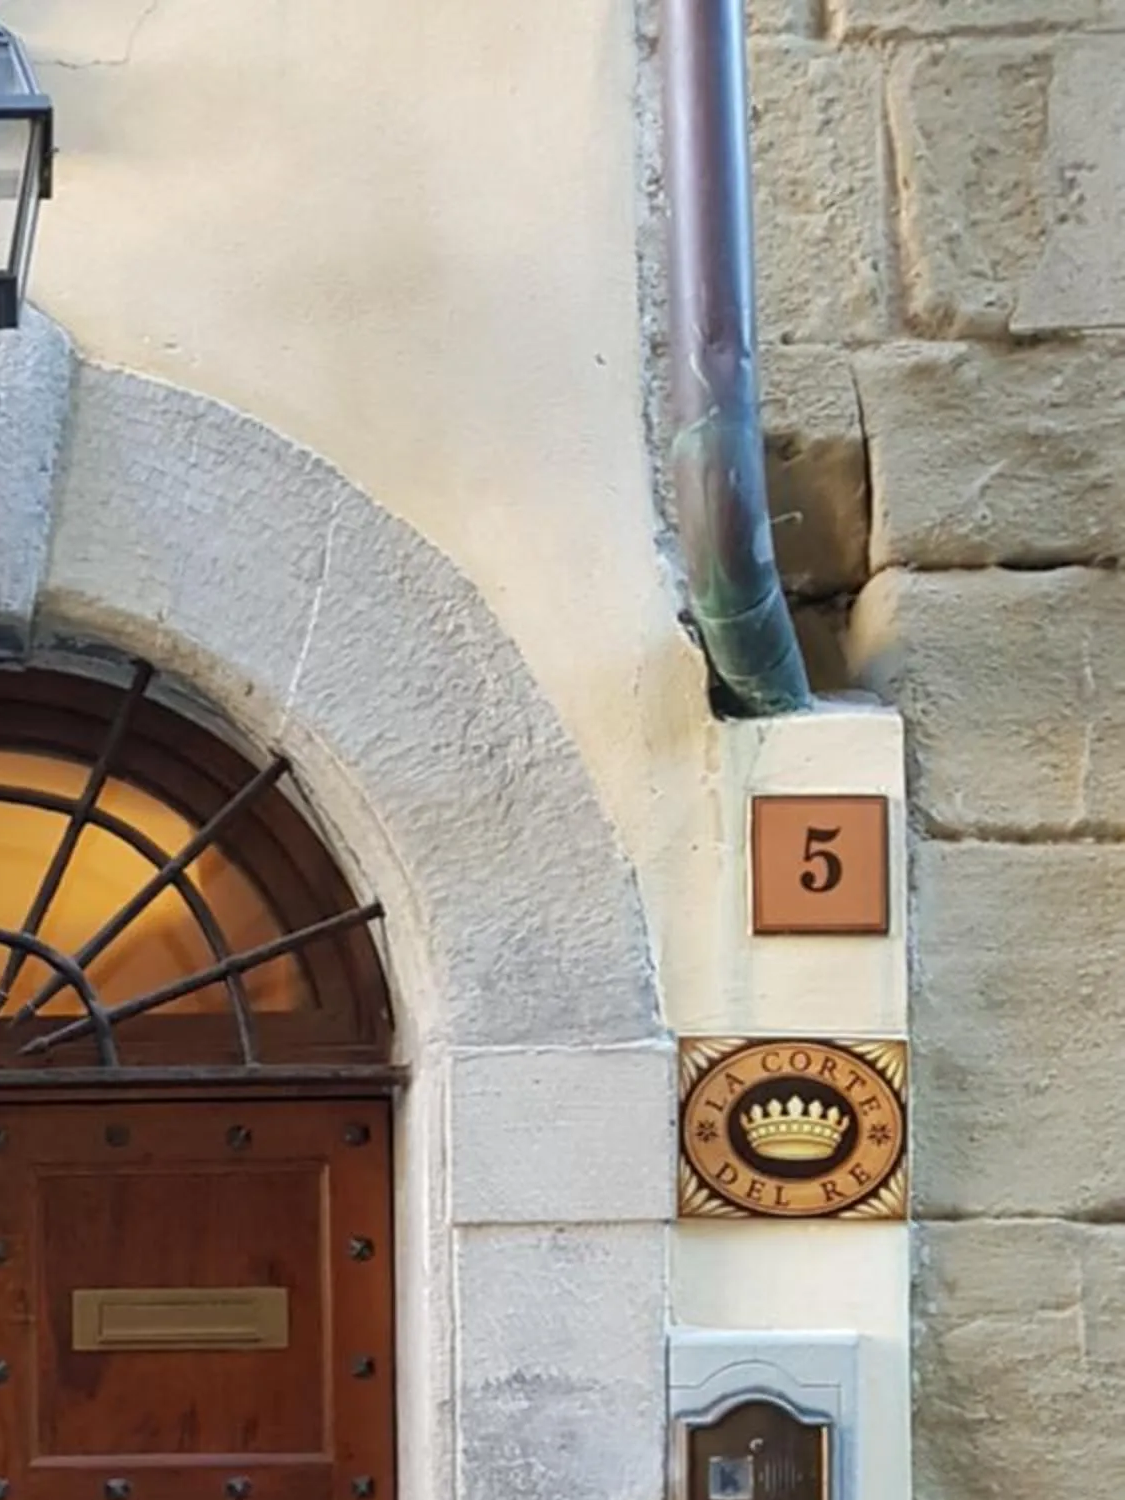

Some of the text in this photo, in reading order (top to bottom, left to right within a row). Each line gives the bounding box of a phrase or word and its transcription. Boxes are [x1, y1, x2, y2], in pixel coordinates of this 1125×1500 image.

[799, 825, 842, 893] 5
[704, 1050, 882, 1117] LA CORTE
[714, 1161, 872, 1207] DEL RE
